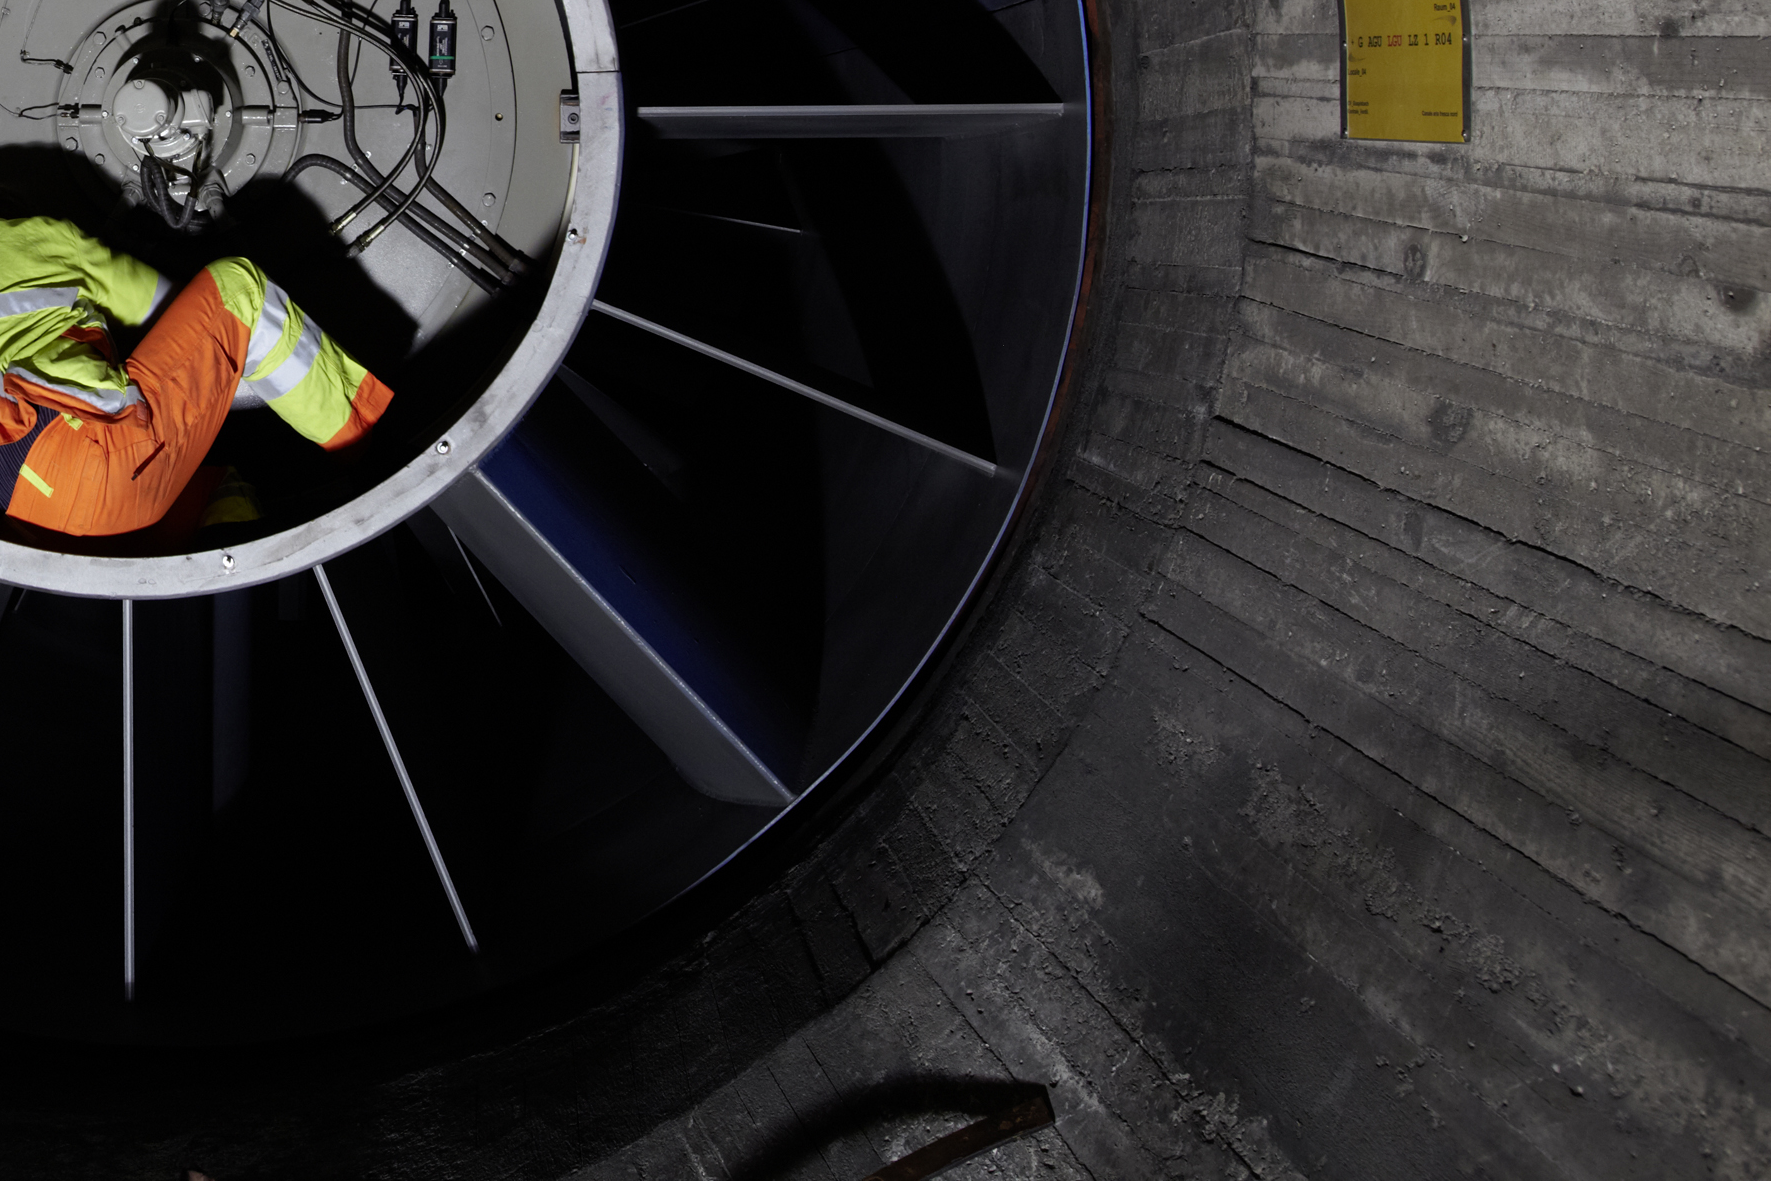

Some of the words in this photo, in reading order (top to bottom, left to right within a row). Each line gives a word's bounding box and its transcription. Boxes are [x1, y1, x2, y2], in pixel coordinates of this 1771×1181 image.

[1357, 36, 1364, 48] G
[1368, 35, 1382, 47] AGU
[1387, 35, 1402, 47] LGU
[1408, 34, 1419, 46] LZ
[1424, 33, 1429, 46] 1
[1435, 32, 1452, 46] R04
